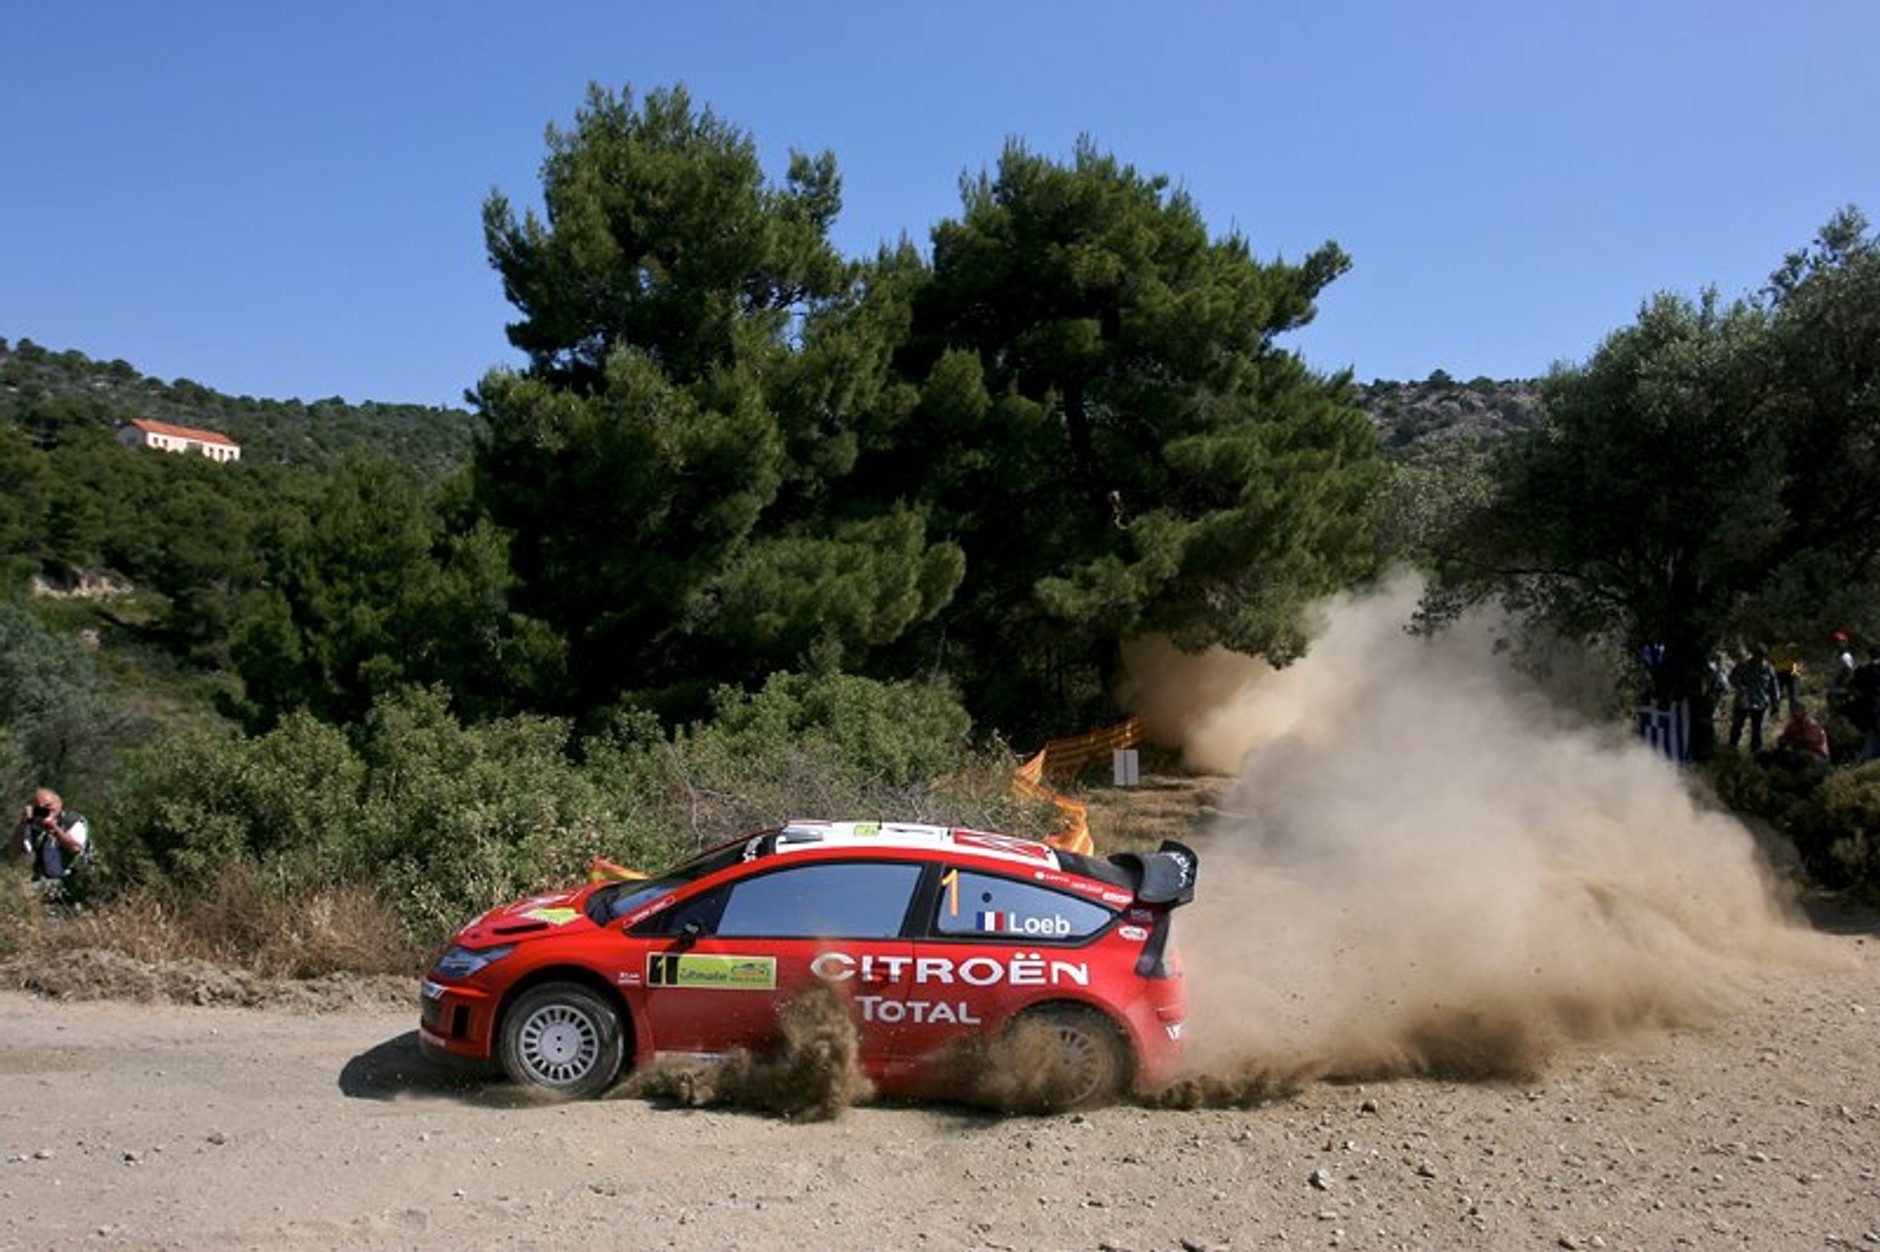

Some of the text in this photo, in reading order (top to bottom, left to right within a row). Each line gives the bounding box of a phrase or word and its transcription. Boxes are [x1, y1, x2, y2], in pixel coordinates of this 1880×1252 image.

[941, 869, 959, 918] 1
[1009, 911, 1070, 934] Loeb
[656, 954, 667, 986] 1
[810, 952, 1089, 985] CITROËN
[854, 996, 981, 1024] TOTAL
